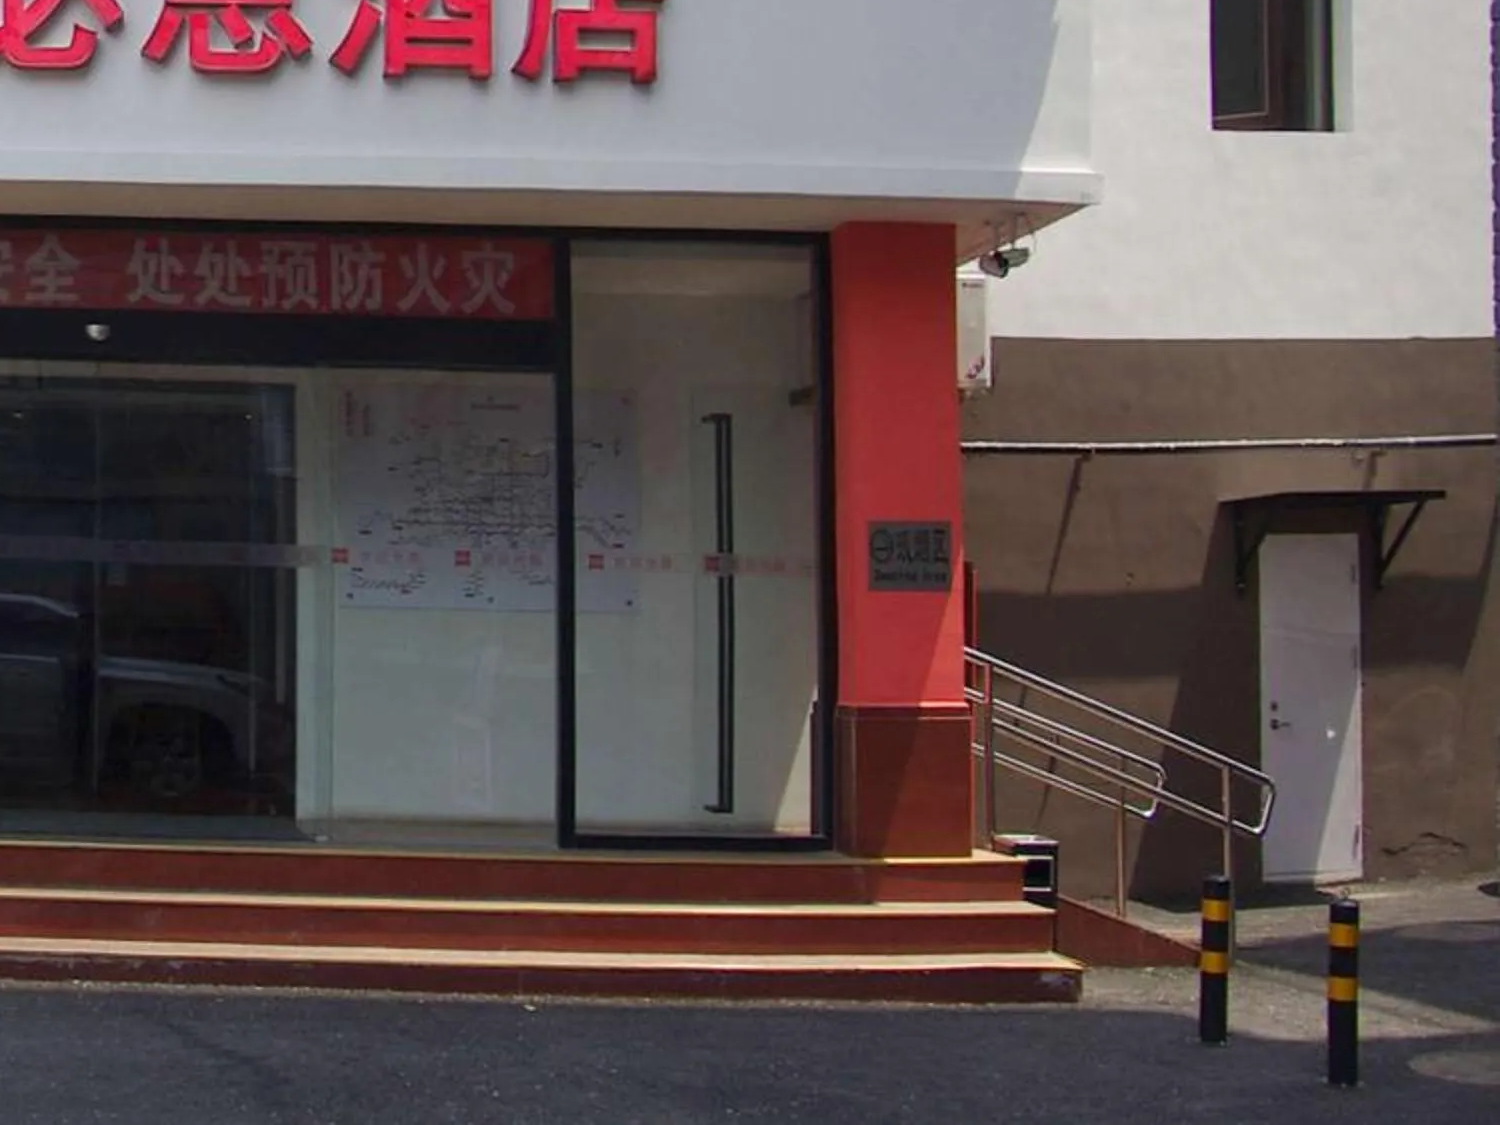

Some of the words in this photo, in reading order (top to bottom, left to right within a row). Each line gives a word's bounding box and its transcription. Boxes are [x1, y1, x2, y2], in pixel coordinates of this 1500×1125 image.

[126, 236, 518, 314] 处处预防火灾
